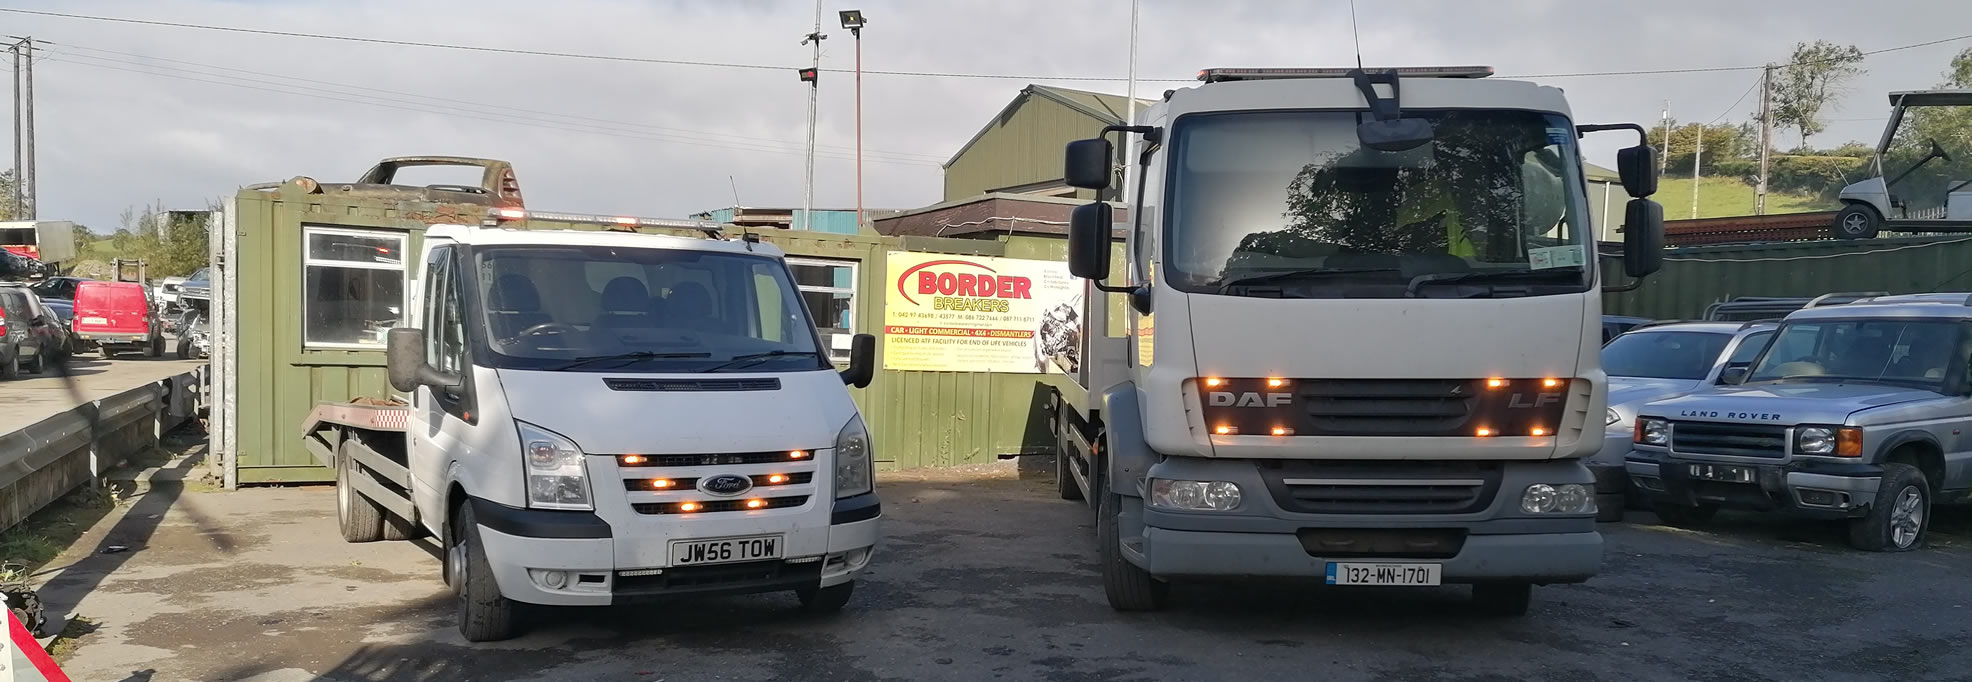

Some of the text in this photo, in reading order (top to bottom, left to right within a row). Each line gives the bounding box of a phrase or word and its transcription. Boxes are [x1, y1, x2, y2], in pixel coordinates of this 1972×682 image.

[918, 271, 1031, 299] BORDER
[934, 297, 1009, 312] BREAKERS
[909, 327, 928, 335] LIGHT
[929, 328, 971, 336] COMMERCIAL
[1209, 391, 1292, 408] DAF
[1508, 392, 1561, 409] LF
[1681, 410, 1781, 421] LAND ROVER
[714, 477, 741, 490] Ford
[680, 538, 776, 563] JW56 TOW
[1345, 567, 1430, 584] 132-MN-1701
